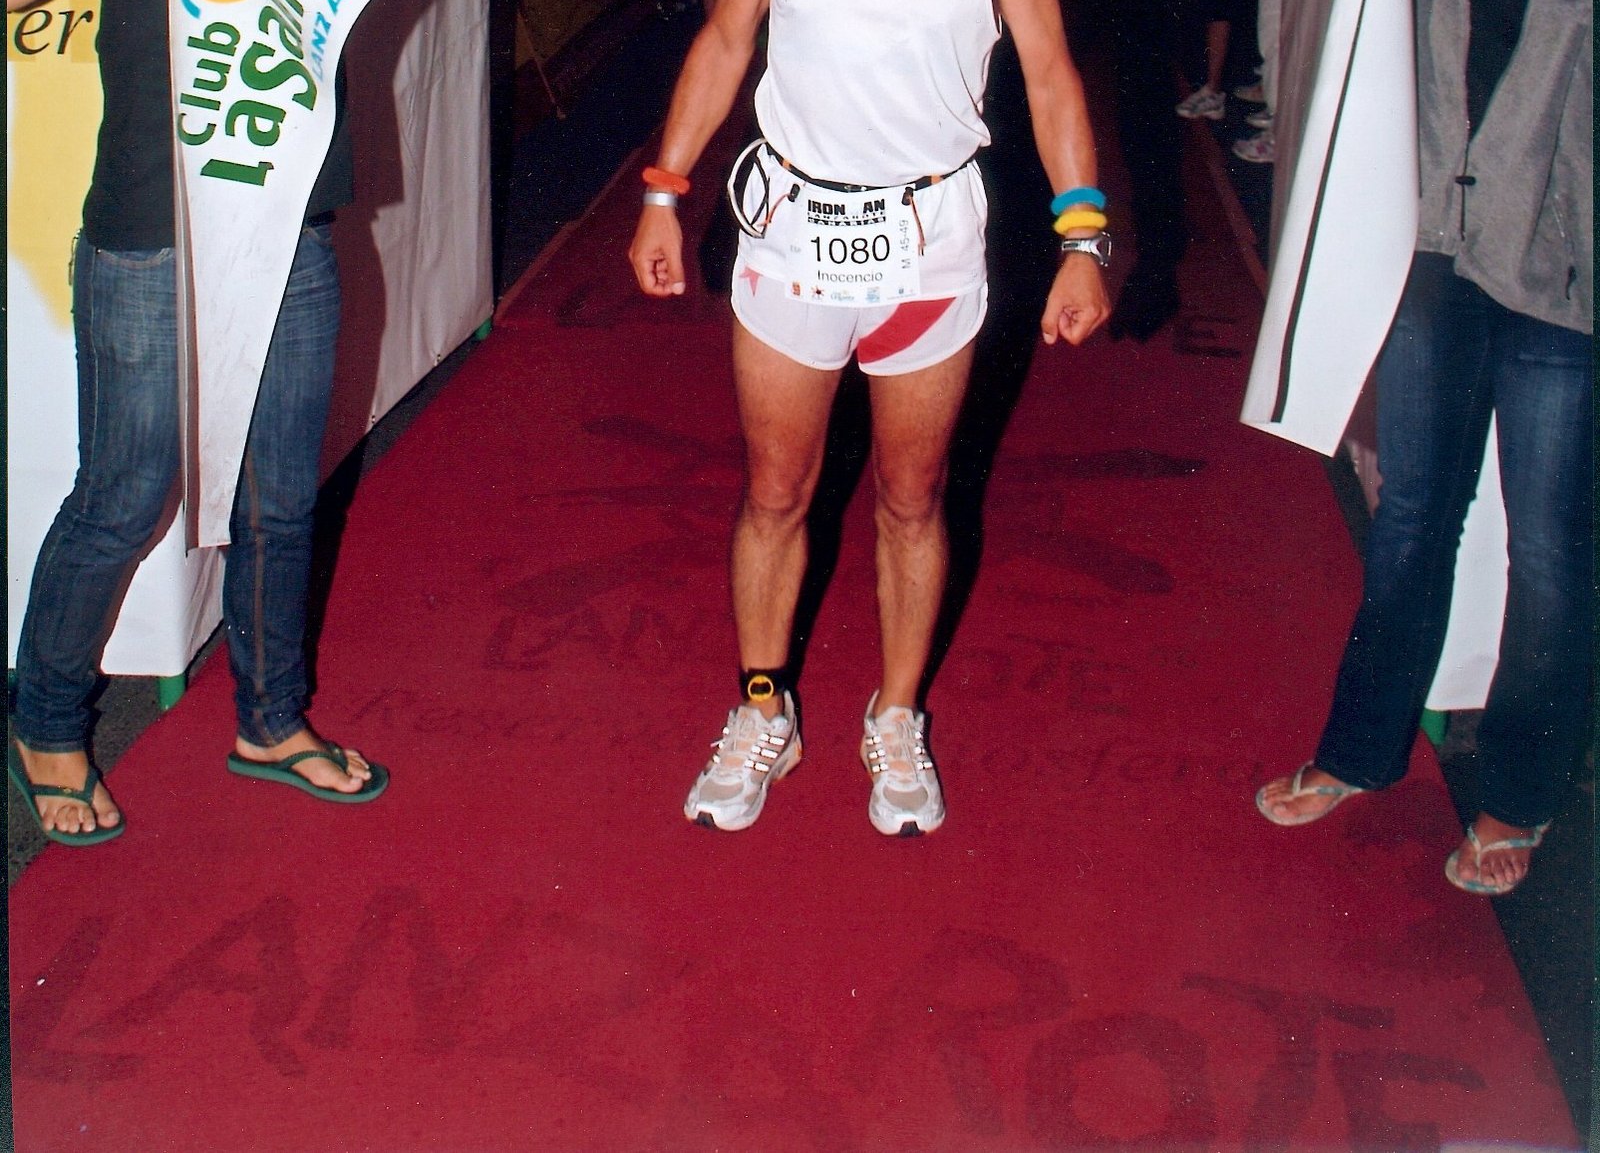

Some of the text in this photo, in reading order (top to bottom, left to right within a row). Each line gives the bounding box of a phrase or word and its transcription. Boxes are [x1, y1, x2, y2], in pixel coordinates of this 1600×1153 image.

[176, 21, 241, 146] Club
[810, 234, 891, 264] 1080
[817, 269, 883, 283] Inocencio
